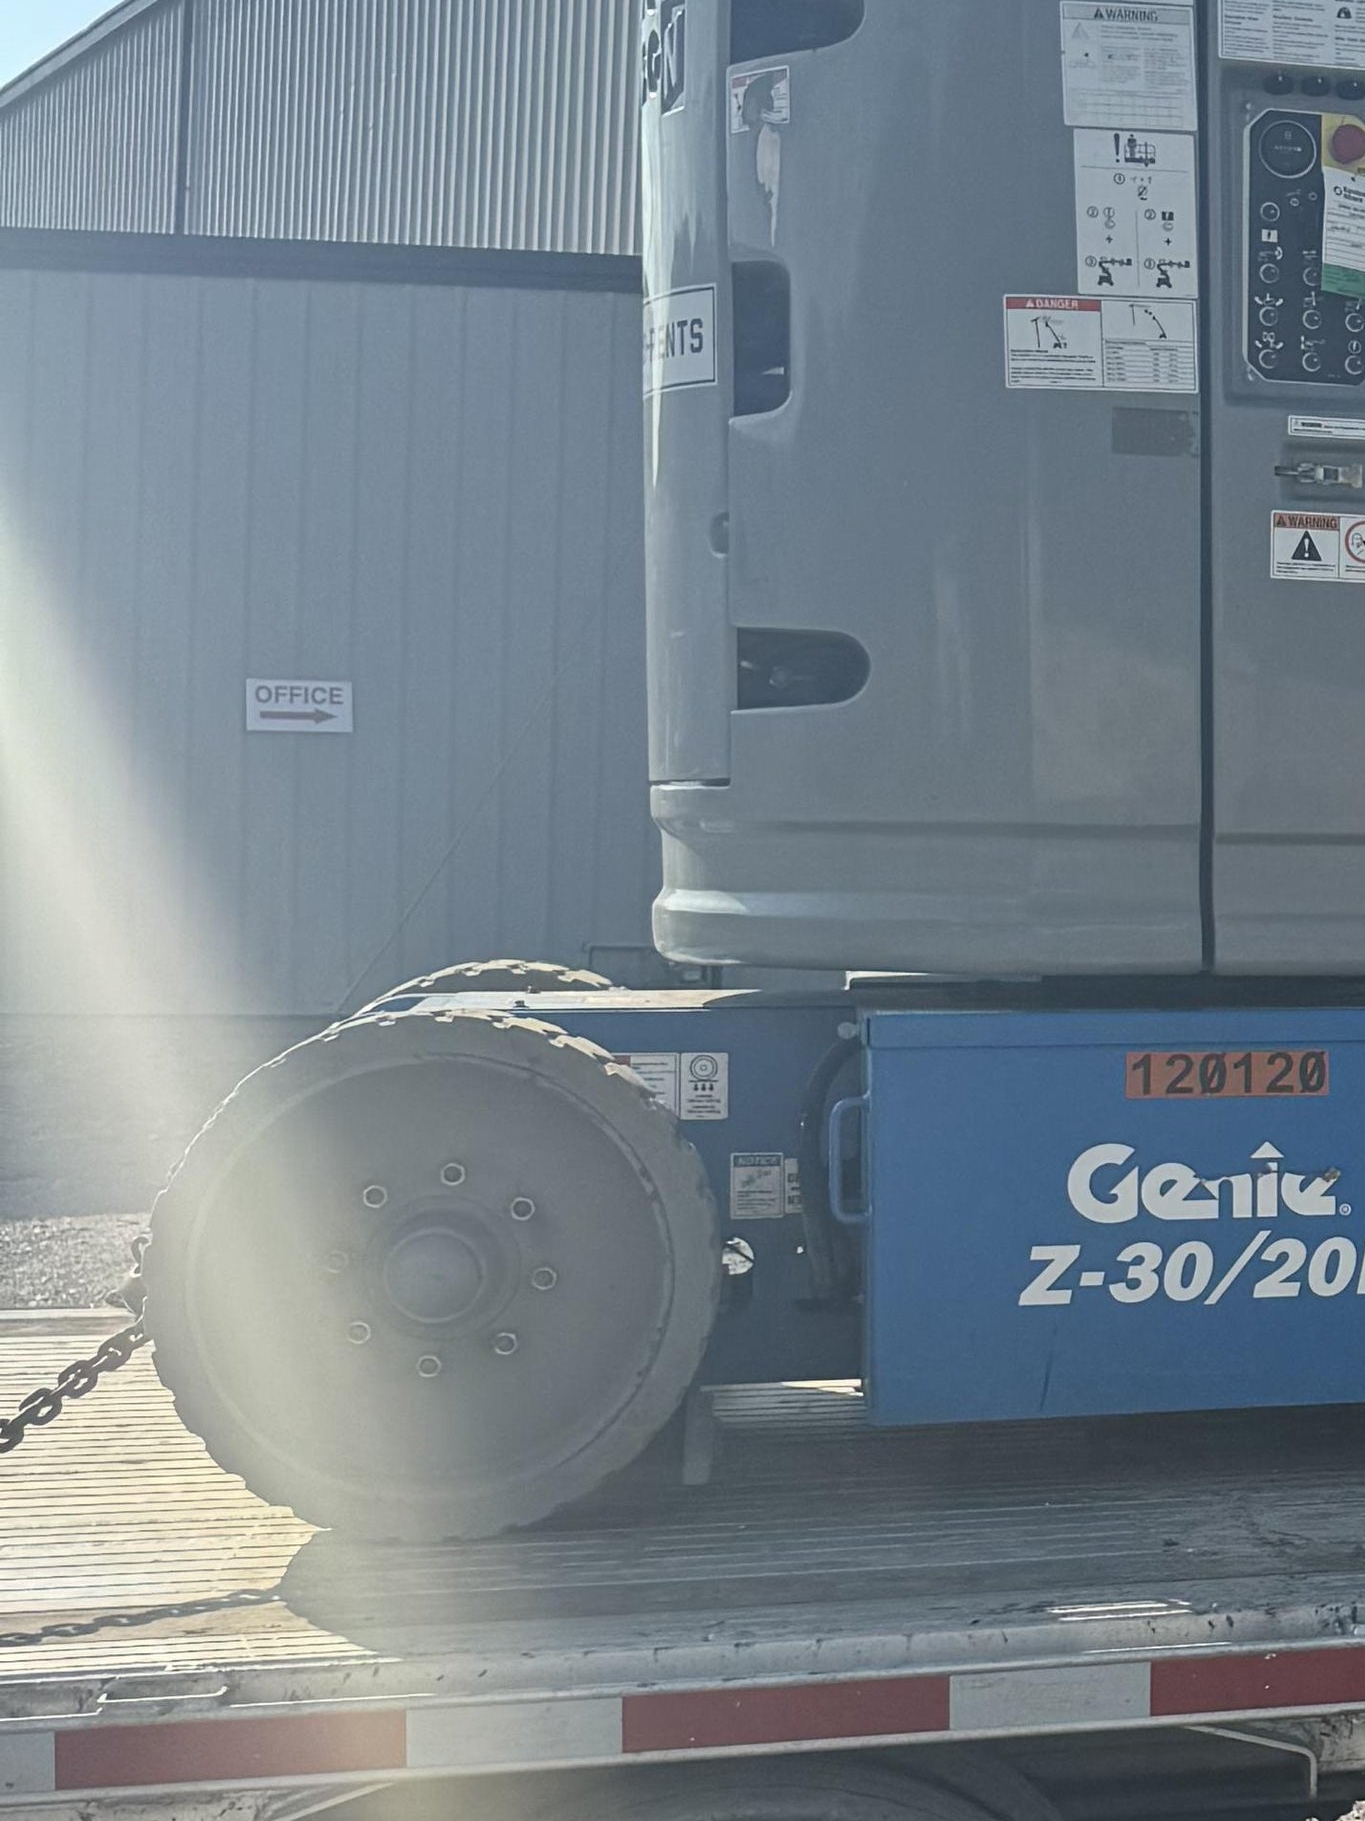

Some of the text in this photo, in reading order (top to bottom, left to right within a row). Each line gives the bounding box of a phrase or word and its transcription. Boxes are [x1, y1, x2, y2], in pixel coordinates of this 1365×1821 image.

[1105, 8, 1158, 22] WARNING
[1035, 298, 1079, 310] DANGER
[1288, 515, 1339, 529] WARNING
[254, 684, 345, 706] OFFICE
[1130, 1053, 1326, 1095] 120120
[1066, 1140, 1342, 1224] Genie
